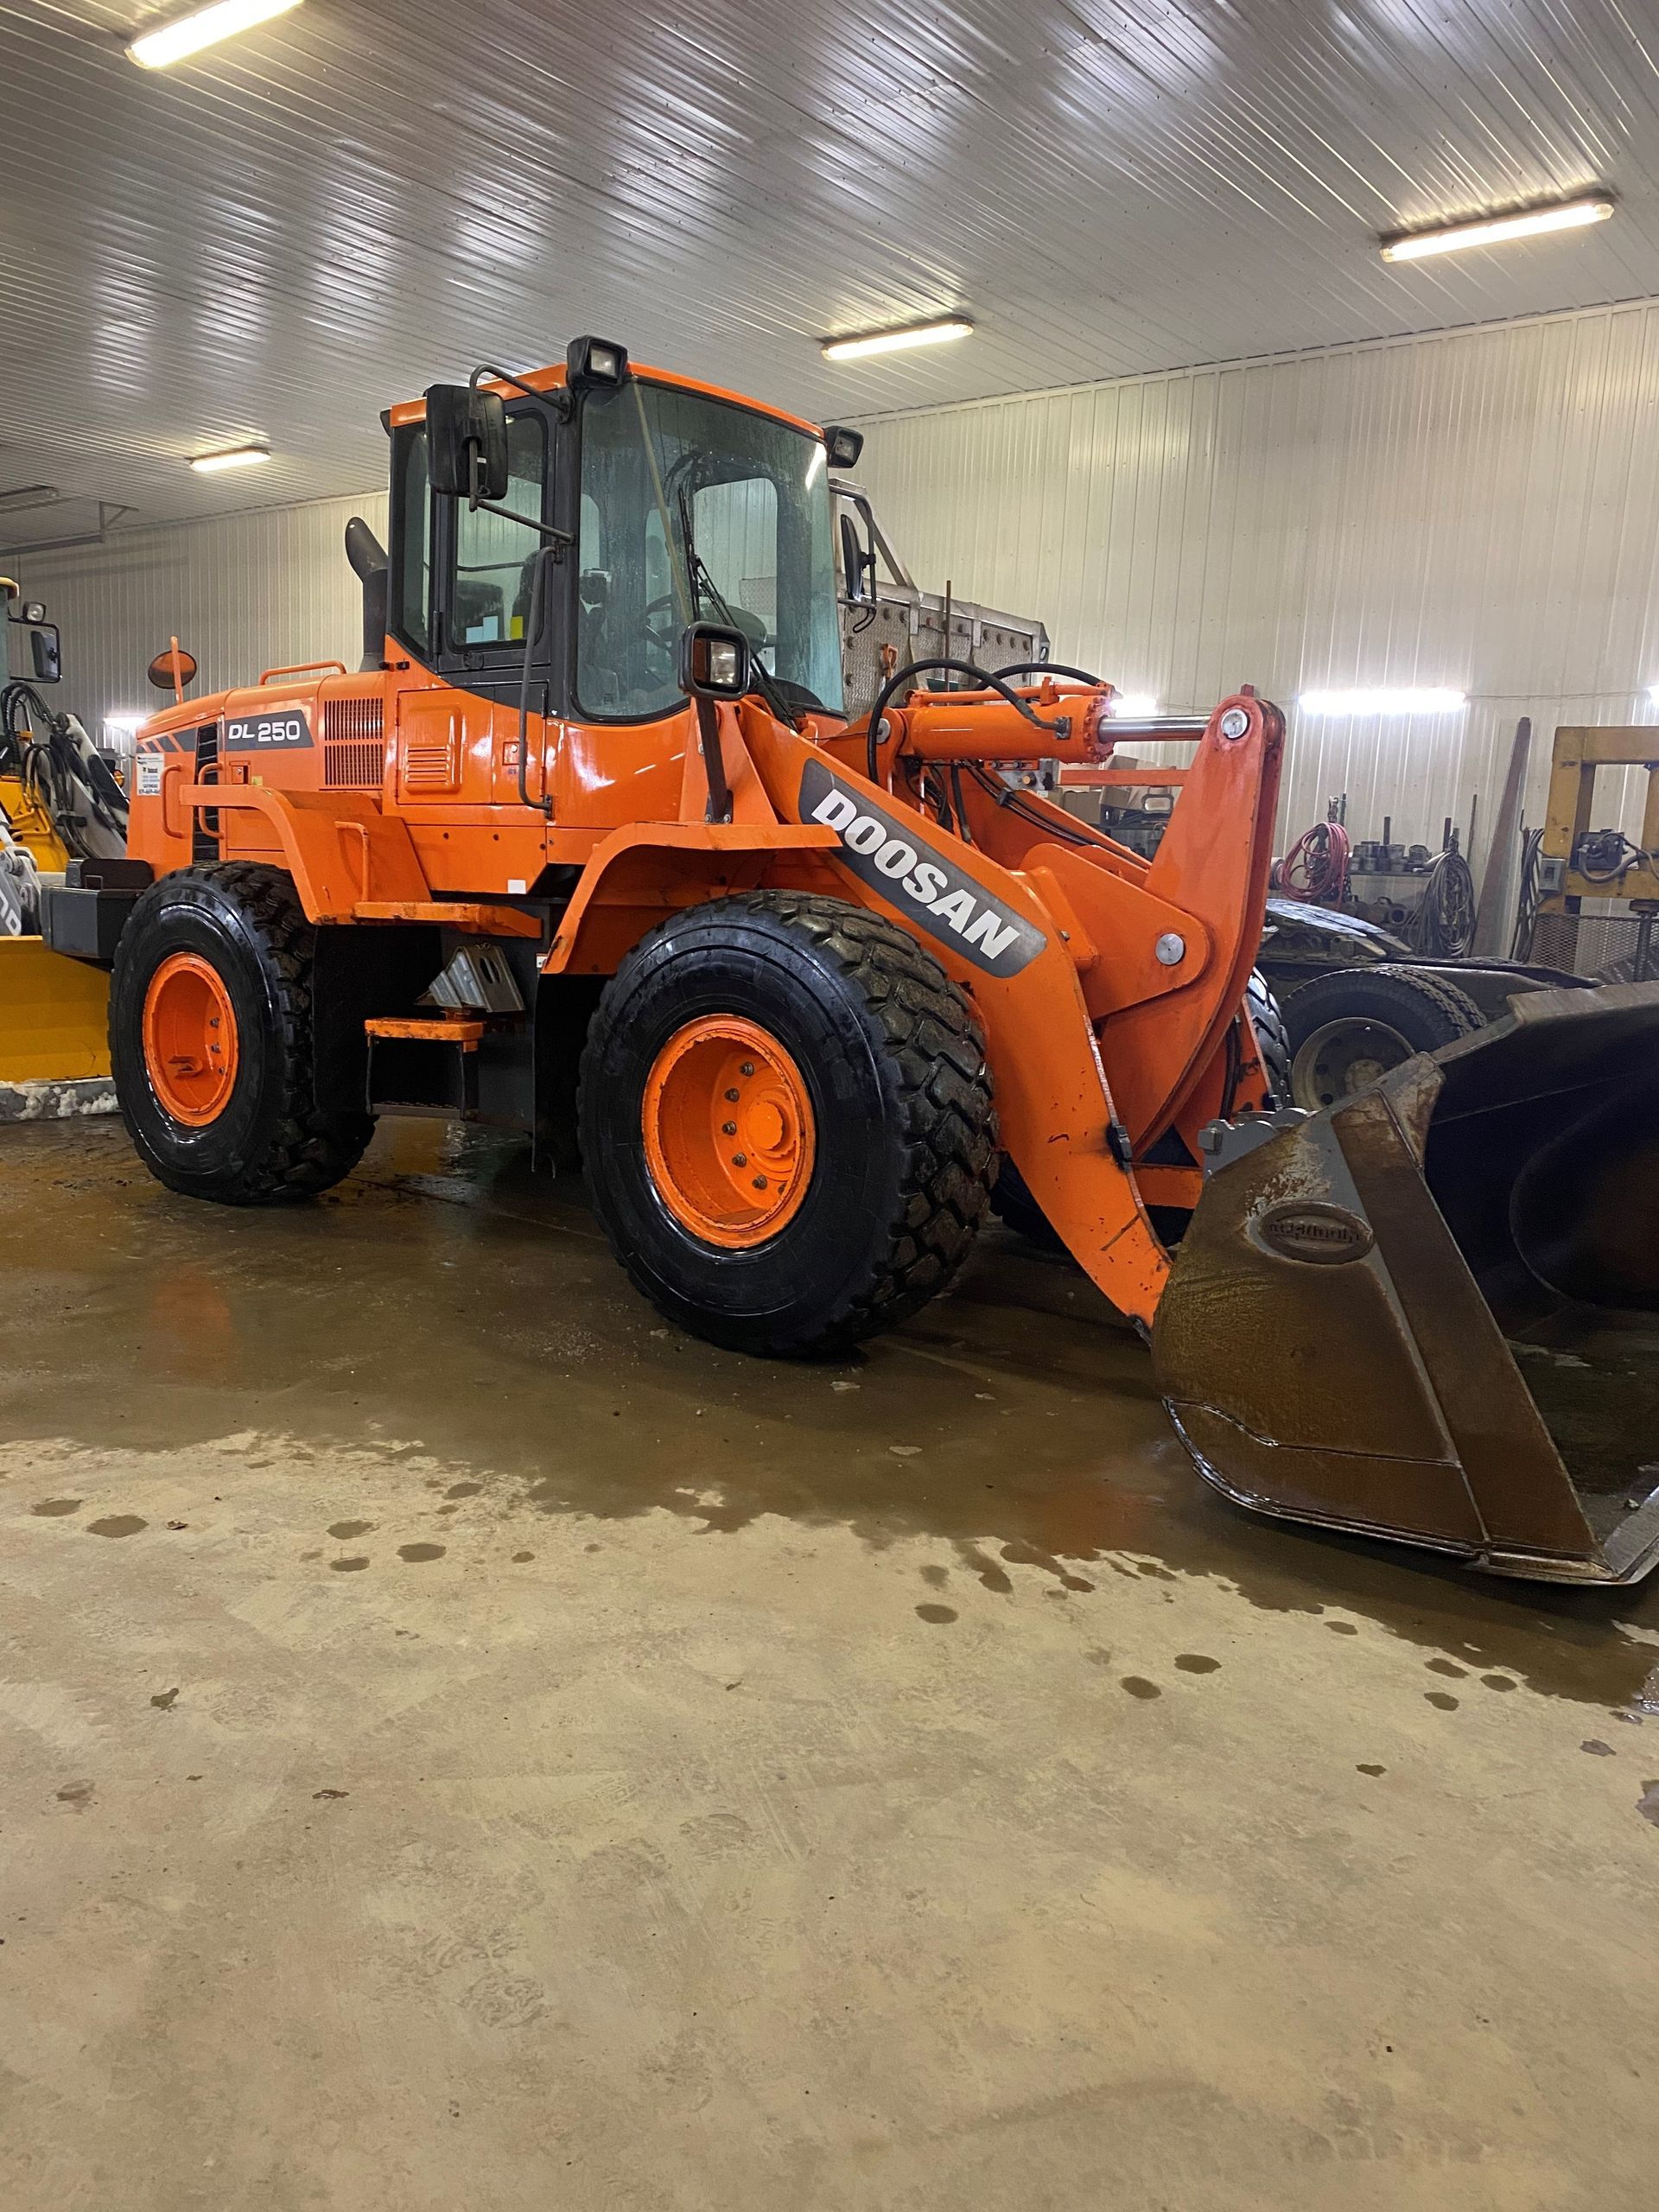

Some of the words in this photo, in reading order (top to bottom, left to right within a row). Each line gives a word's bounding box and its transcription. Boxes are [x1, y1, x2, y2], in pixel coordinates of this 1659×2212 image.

[228, 724, 256, 740] DL
[257, 721, 301, 742] 250
[810, 788, 1020, 960] DOOSAN
